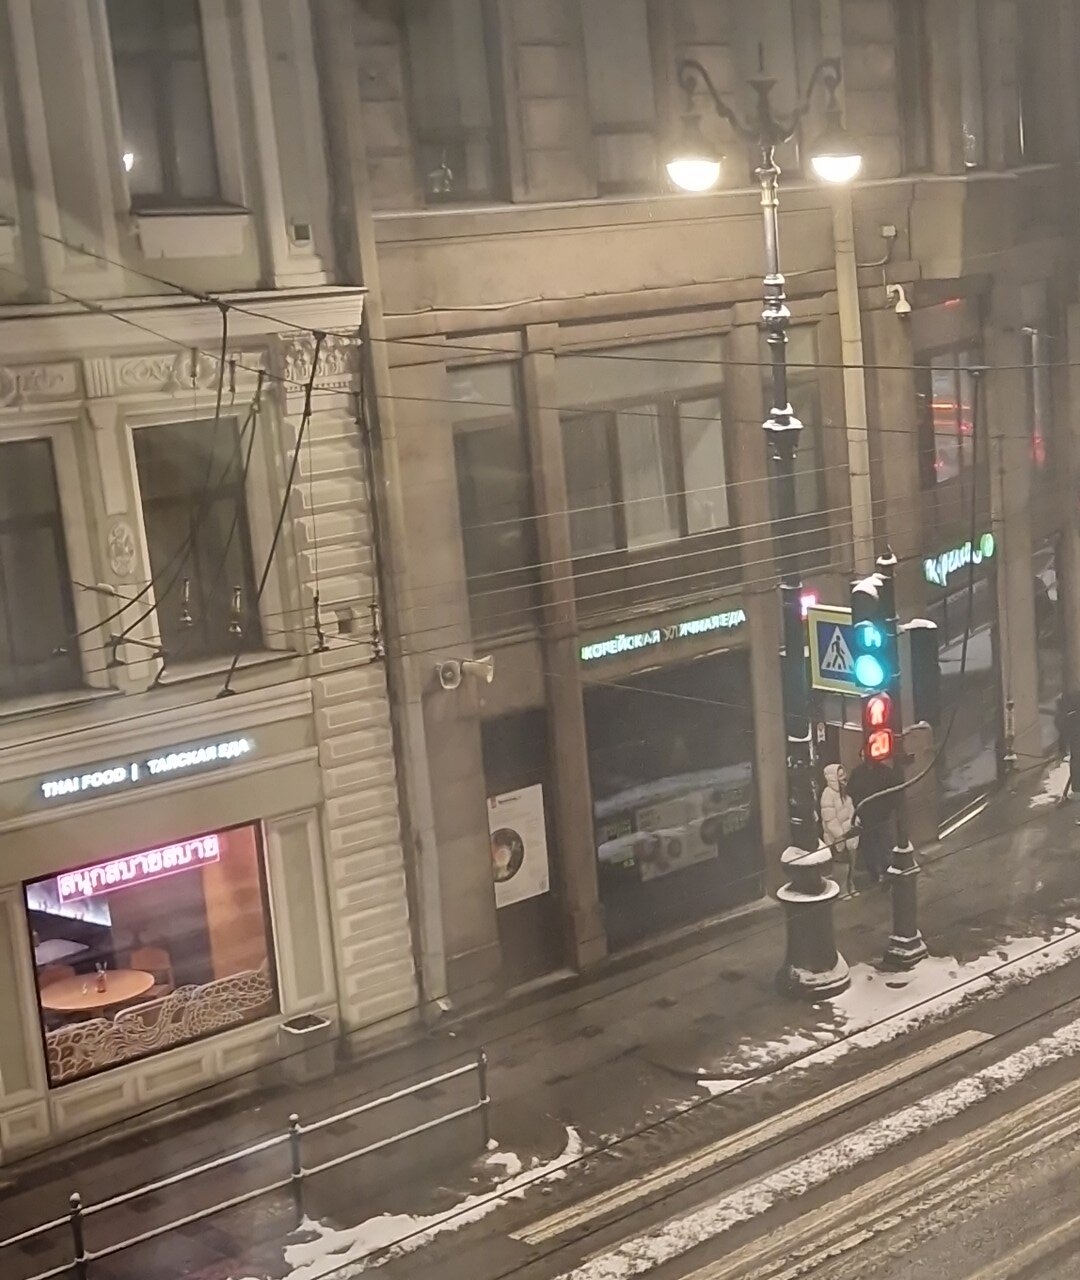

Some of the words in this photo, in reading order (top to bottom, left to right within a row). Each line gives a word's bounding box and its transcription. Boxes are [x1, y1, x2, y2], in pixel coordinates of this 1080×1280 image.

[581, 629, 660, 660] КОРЕЙСКАЯ
[662, 616, 719, 640] УЛИЧНАЯ
[719, 609, 746, 628] ЕДА
[147, 745, 217, 774] ТАЙСКАЯ
[217, 738, 250, 759] ЕДА
[41, 777, 79, 798] THAI
[81, 767, 126, 790] FOOD
